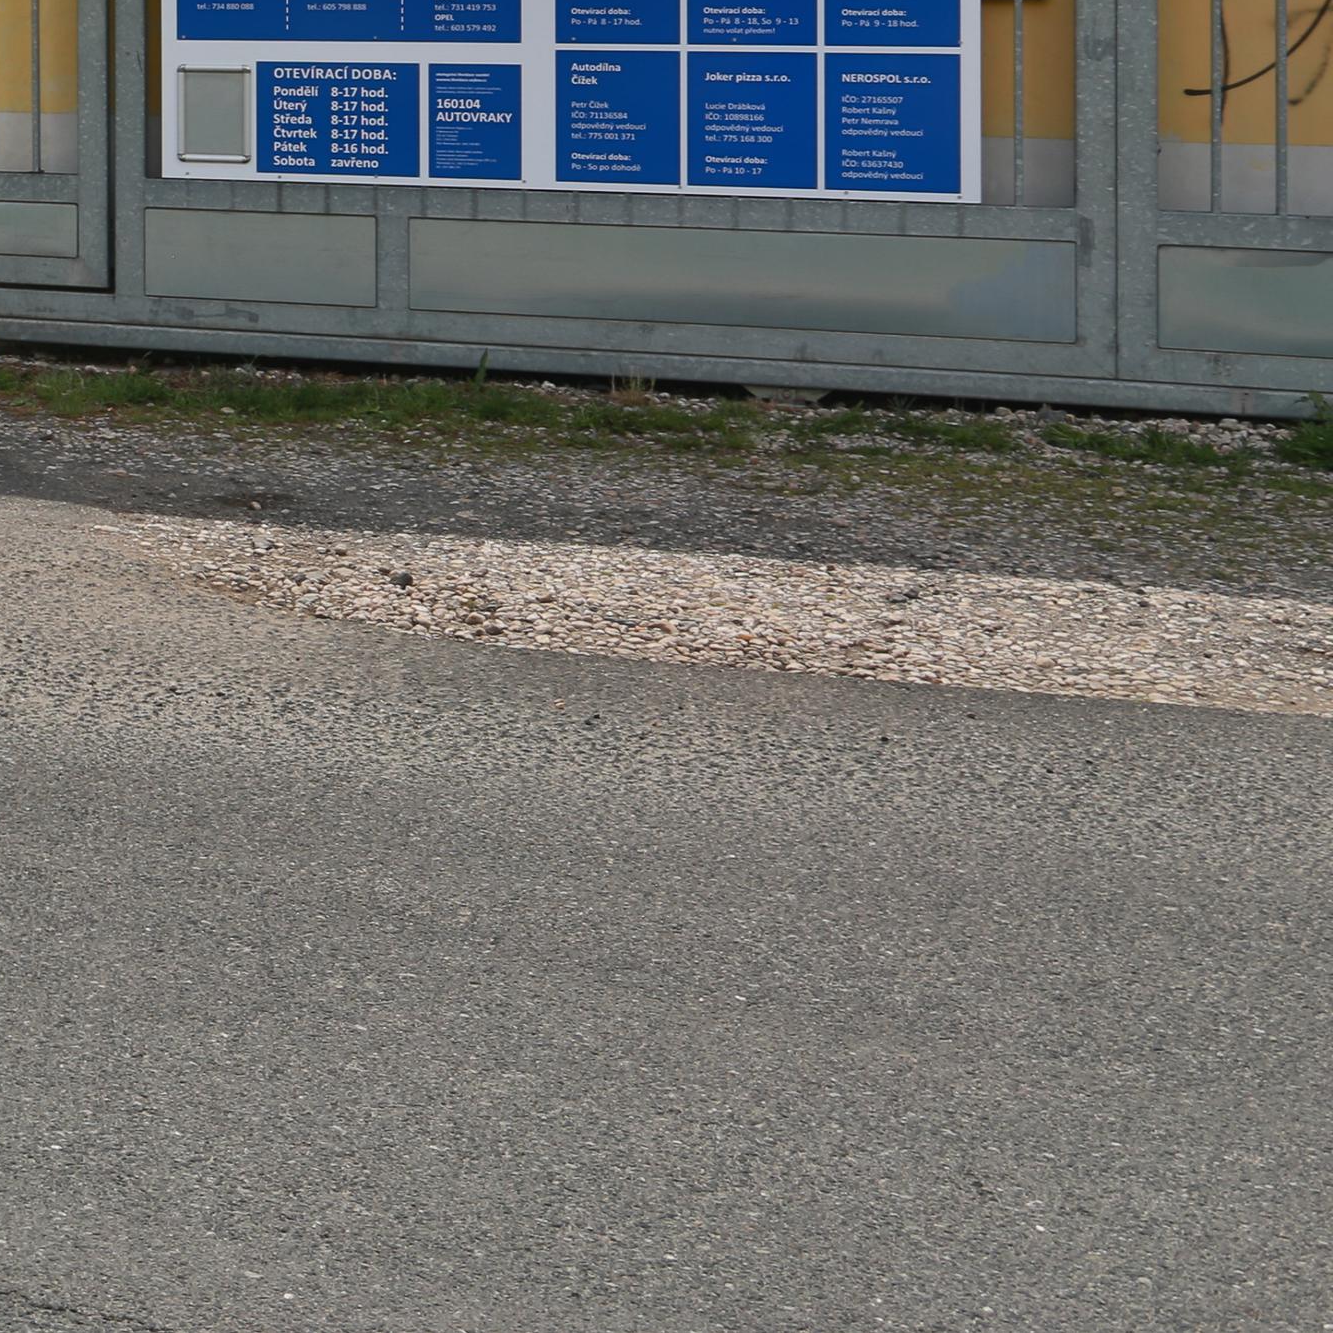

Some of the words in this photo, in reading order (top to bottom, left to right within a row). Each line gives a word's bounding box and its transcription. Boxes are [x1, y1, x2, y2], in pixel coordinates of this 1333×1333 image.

[703, 6, 740, 14] Otevírací
[841, 8, 880, 16] Otevírací
[624, 18, 642, 26] hod.
[703, 17, 714, 25] Po
[721, 17, 731, 25] Pá
[451, 24, 465, 32] 603
[467, 24, 481, 32] 579
[482, 24, 497, 32] 492
[571, 63, 621, 72] Autodílna
[274, 66, 348, 80] OTEVÍRACÍ
[351, 69, 397, 80] DOBA:
[705, 72, 733, 81] Joker
[736, 73, 762, 83] pizza
[764, 74, 791, 82] s.r.o.
[571, 74, 598, 85] Čížek
[841, 74, 902, 83] NEROSPOL
[903, 76, 931, 84] s.r.o.
[273, 86, 318, 96] Pondělí
[331, 87, 357, 97] 8-17
[361, 87, 389, 98] hod.
[273, 98, 307, 112] Úterý
[331, 101, 357, 111] 8-17
[361, 102, 389, 112] hod.
[436, 99, 480, 109] 160104
[872, 107, 896, 115] Kašný
[273, 114, 312, 124] Středa
[331, 115, 357, 125] 8-17
[361, 116, 389, 126] hod.
[436, 112, 512, 123] AUTOVRAKY
[571, 122, 614, 130] odpovědný
[705, 124, 750, 132] odpovědný
[273, 125, 317, 138] Čtvrtek
[331, 129, 357, 139] 8-17
[361, 130, 389, 140] hod.
[841, 128, 888, 137] odpovědný
[273, 141, 307, 152] Pátek
[331, 143, 357, 154] 8-16
[361, 144, 389, 154] hod.
[571, 152, 607, 160] Otevírací
[872, 150, 896, 158] Kašný
[273, 156, 315, 166] Sobota
[331, 157, 379, 168] zavřeno
[705, 155, 742, 163] Otevírací
[841, 171, 888, 180] odpovědný
